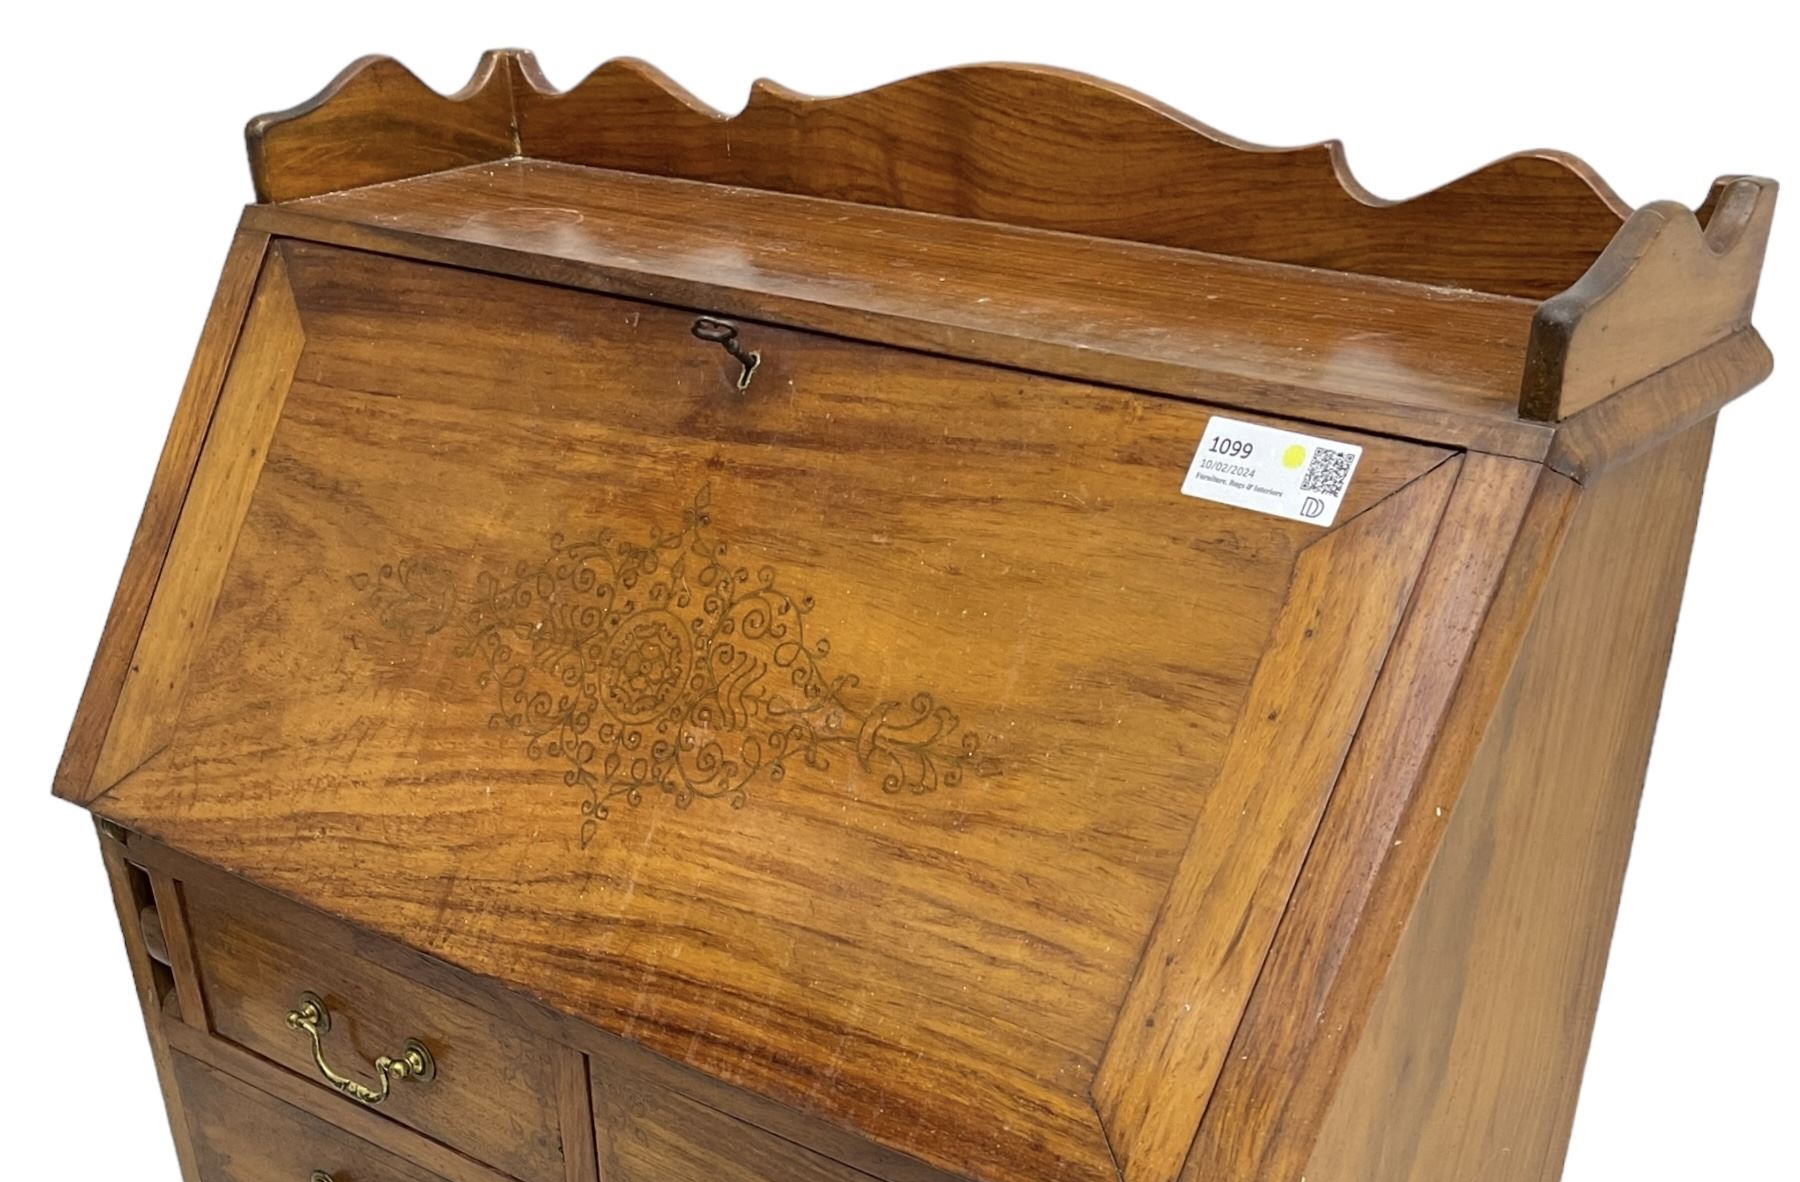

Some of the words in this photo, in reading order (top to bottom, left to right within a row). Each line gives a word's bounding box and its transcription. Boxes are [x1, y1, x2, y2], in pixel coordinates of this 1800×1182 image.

[1208, 436, 1253, 459] 1099
[1200, 459, 1256, 478] 10/02/2024
[1253, 485, 1283, 497] Interiors
